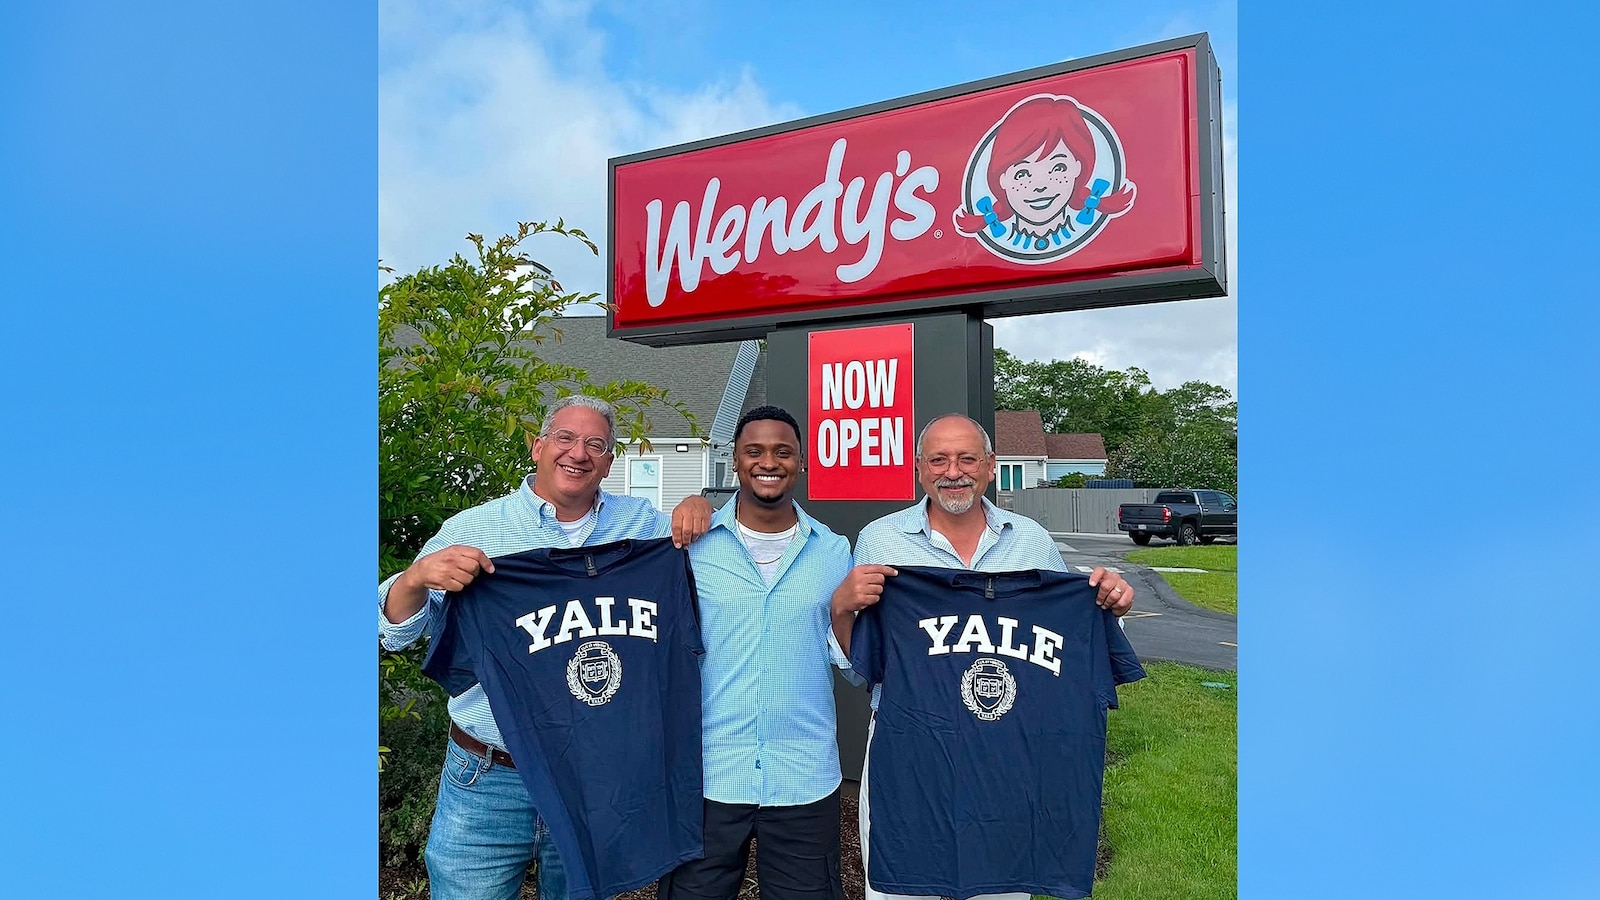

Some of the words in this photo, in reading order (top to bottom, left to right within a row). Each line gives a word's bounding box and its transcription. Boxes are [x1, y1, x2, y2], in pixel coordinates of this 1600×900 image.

[646, 138, 939, 307] Wendy's
[822, 358, 898, 410] NOW
[817, 417, 904, 467] OPEN
[515, 597, 658, 654] YALE
[918, 615, 1064, 674] YALE
